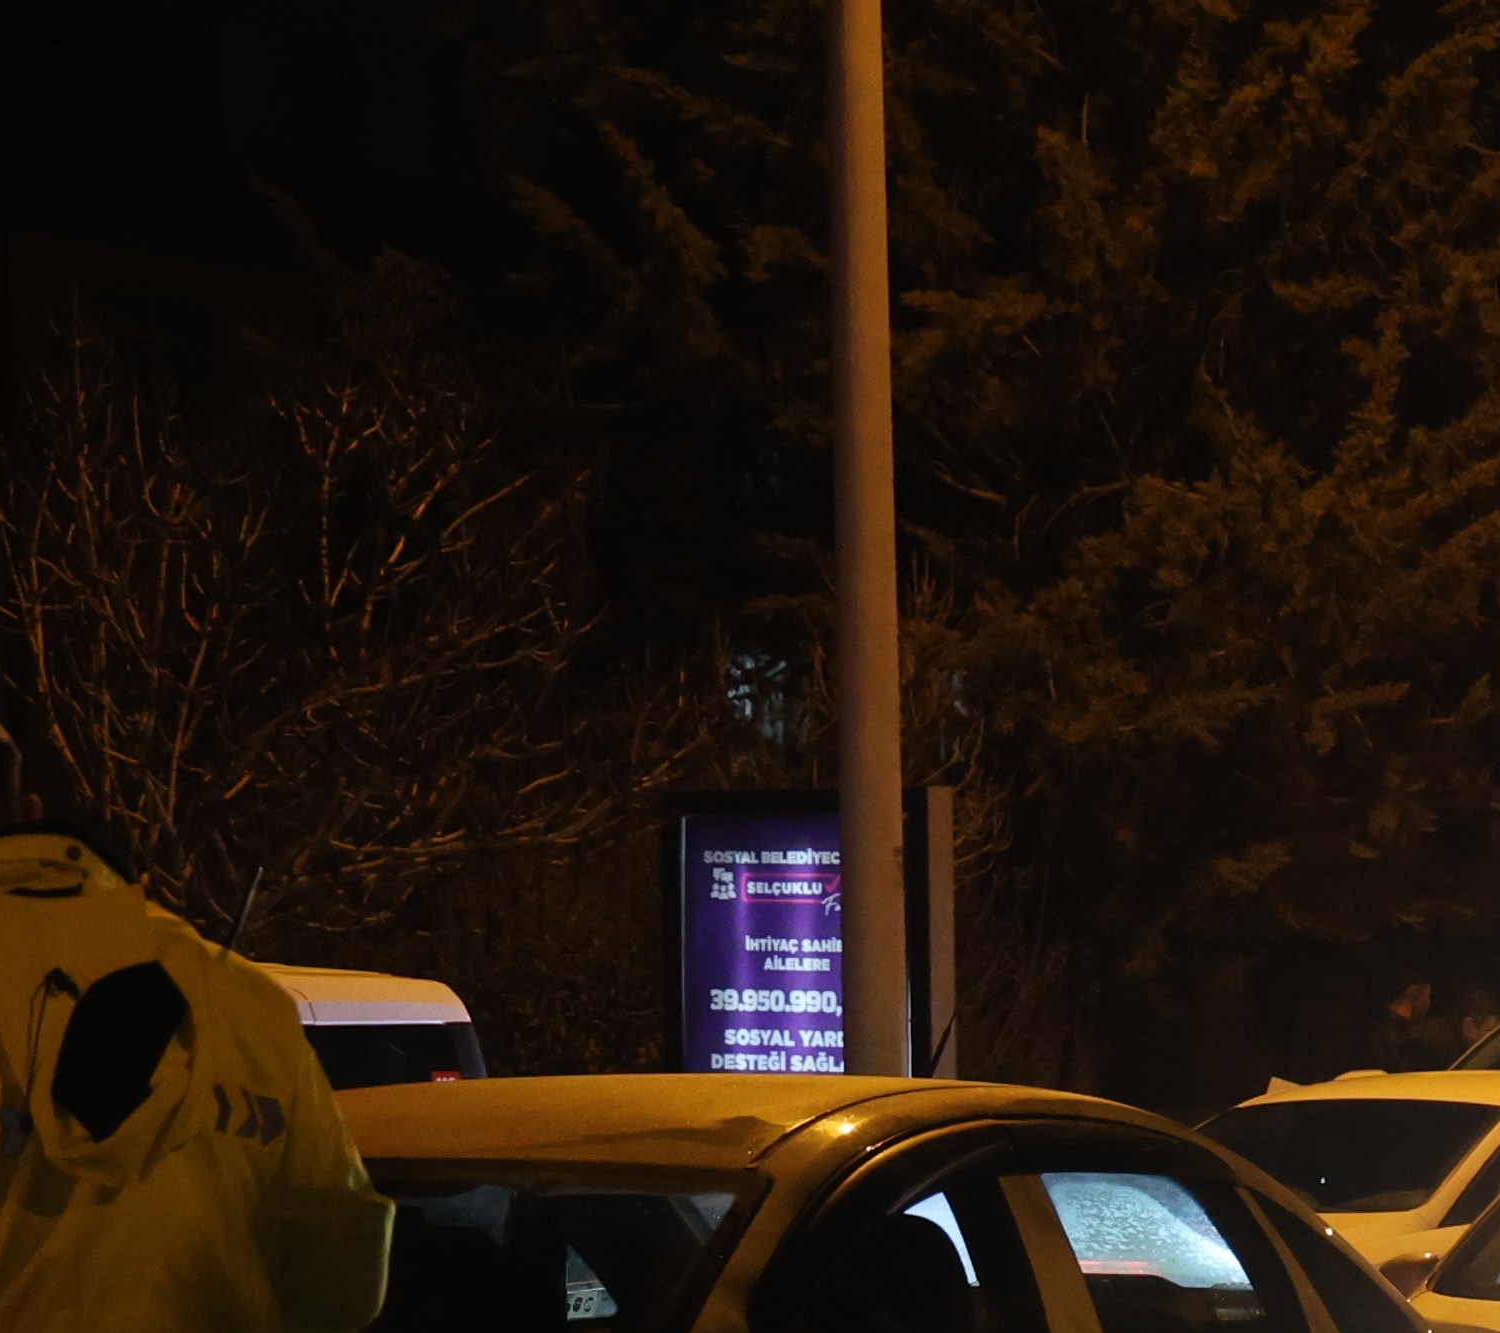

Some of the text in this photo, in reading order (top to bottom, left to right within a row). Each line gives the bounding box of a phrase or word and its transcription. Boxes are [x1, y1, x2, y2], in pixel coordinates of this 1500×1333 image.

[703, 850, 759, 865] SOSYAL
[746, 881, 823, 899] SELÇUKLU
[745, 935, 799, 954] İHTİYAÇ
[763, 957, 831, 972] AİLELERE
[724, 1029, 795, 1048] SOSYAL
[710, 1052, 786, 1071] DESTEĞİ
